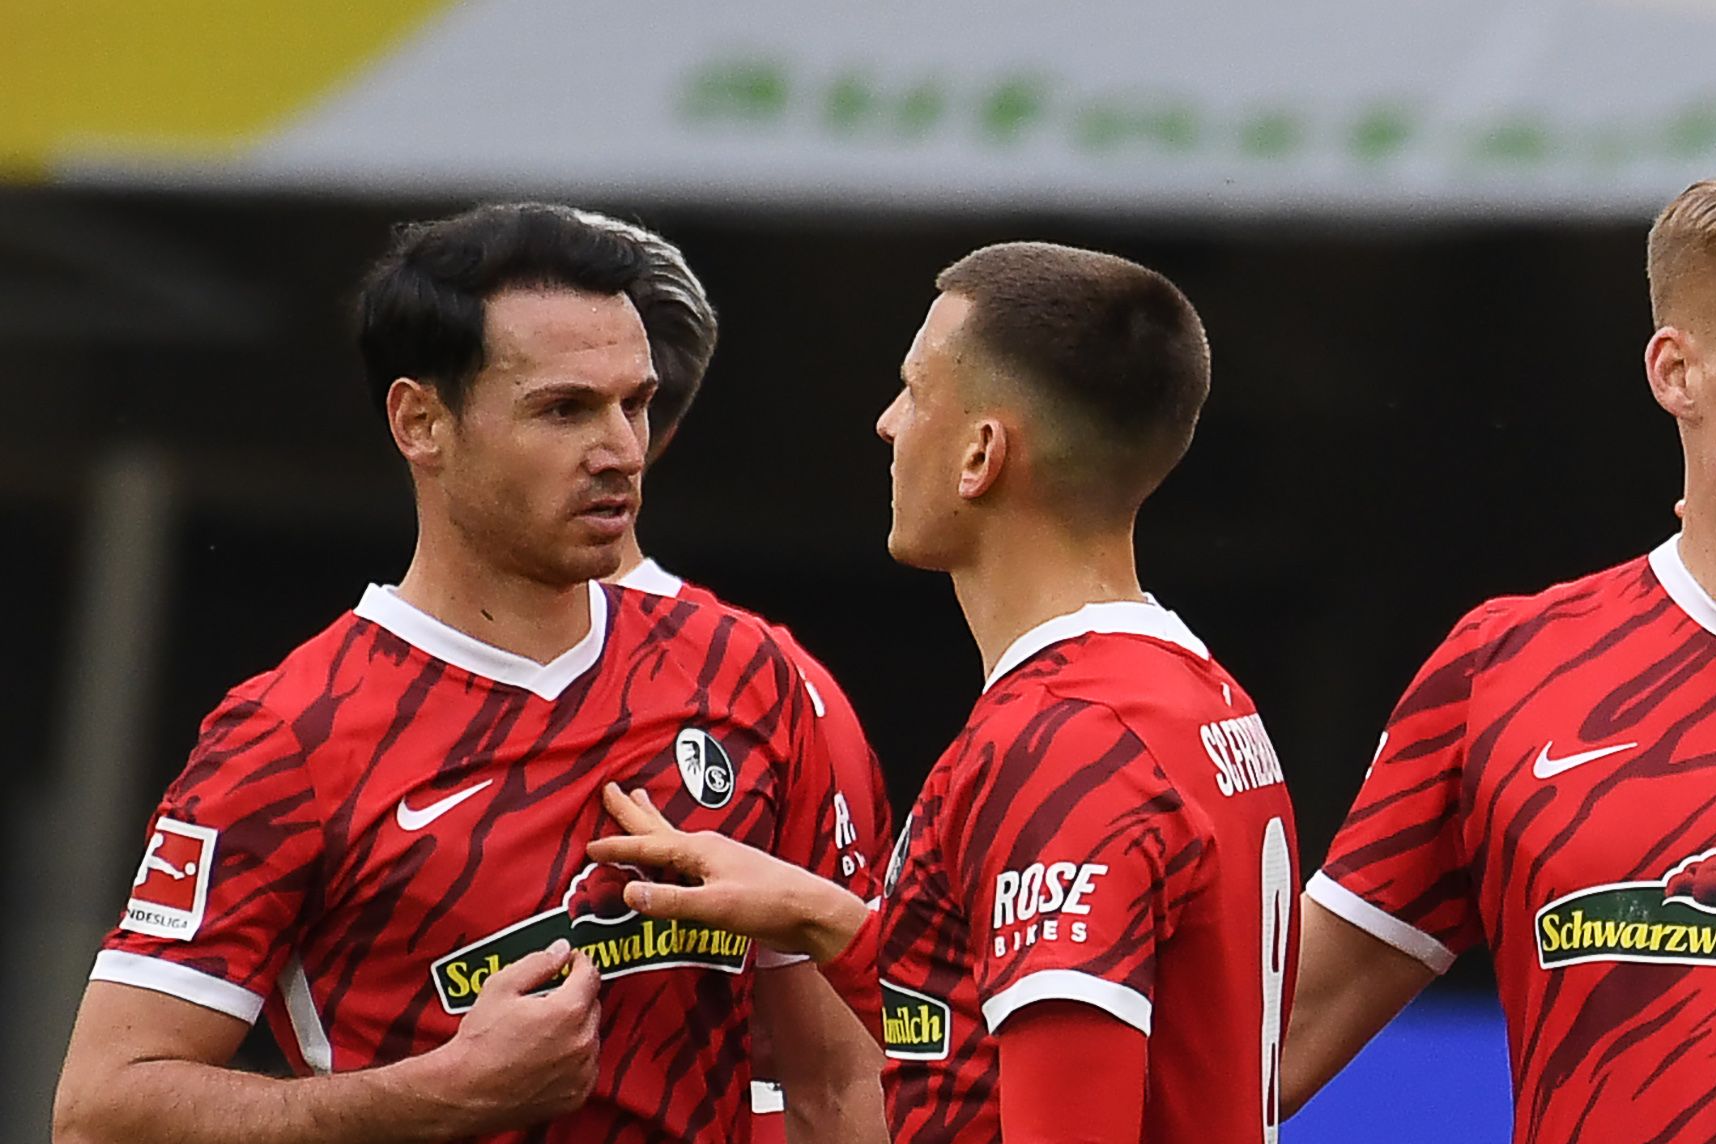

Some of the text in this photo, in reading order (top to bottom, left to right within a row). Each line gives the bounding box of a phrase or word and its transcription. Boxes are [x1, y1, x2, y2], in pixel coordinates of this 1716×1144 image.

[992, 861, 1109, 929] ROSE
[127, 909, 188, 929] NDESLIGA
[993, 919, 1088, 958] BIKES
